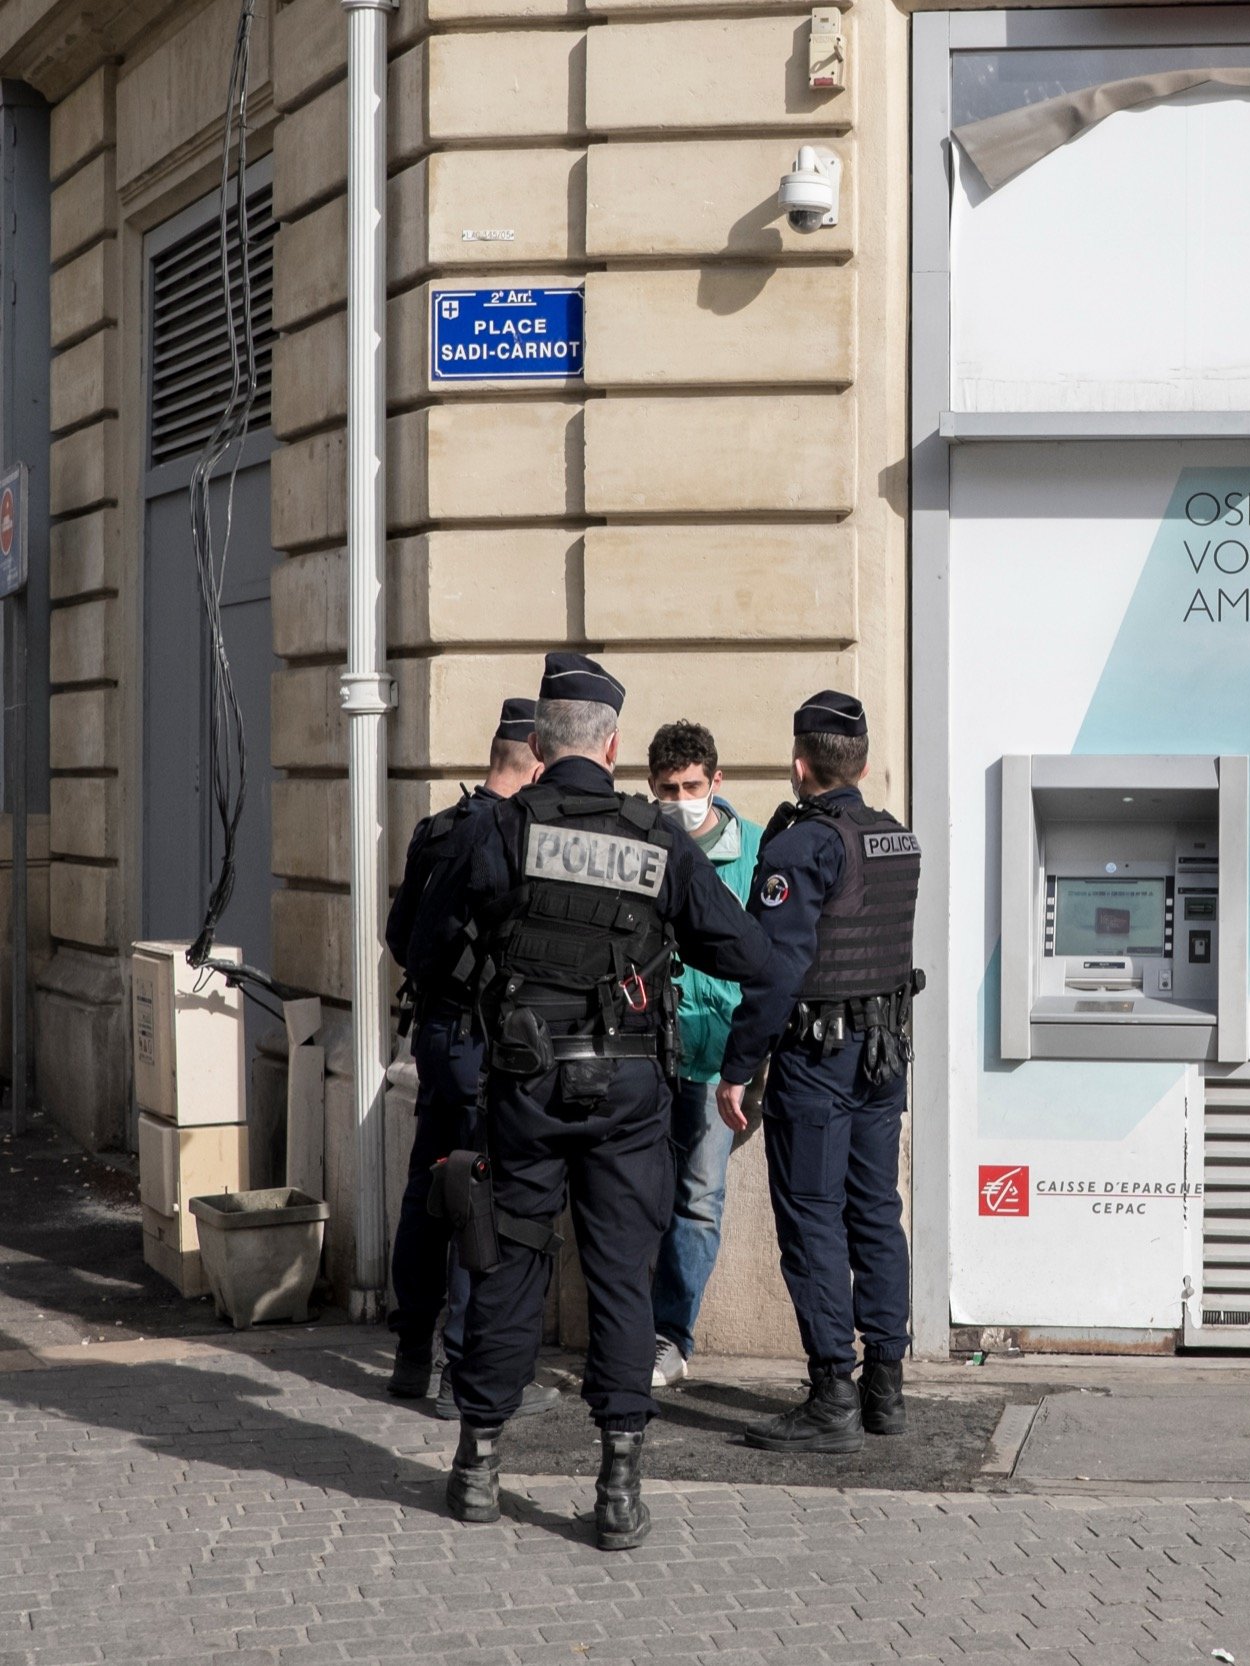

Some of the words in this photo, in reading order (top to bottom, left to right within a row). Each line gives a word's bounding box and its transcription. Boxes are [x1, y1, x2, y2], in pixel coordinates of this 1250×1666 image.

[474, 319, 547, 335] PLACE
[441, 341, 580, 361] SADI-CARNOT
[869, 835, 920, 854] POLICE
[535, 832, 660, 888] POLICE
[1036, 1180, 1096, 1193] CAISSE
[1104, 1181, 1202, 1195] D'EPARGNE
[1092, 1202, 1147, 1215] CEPAC
